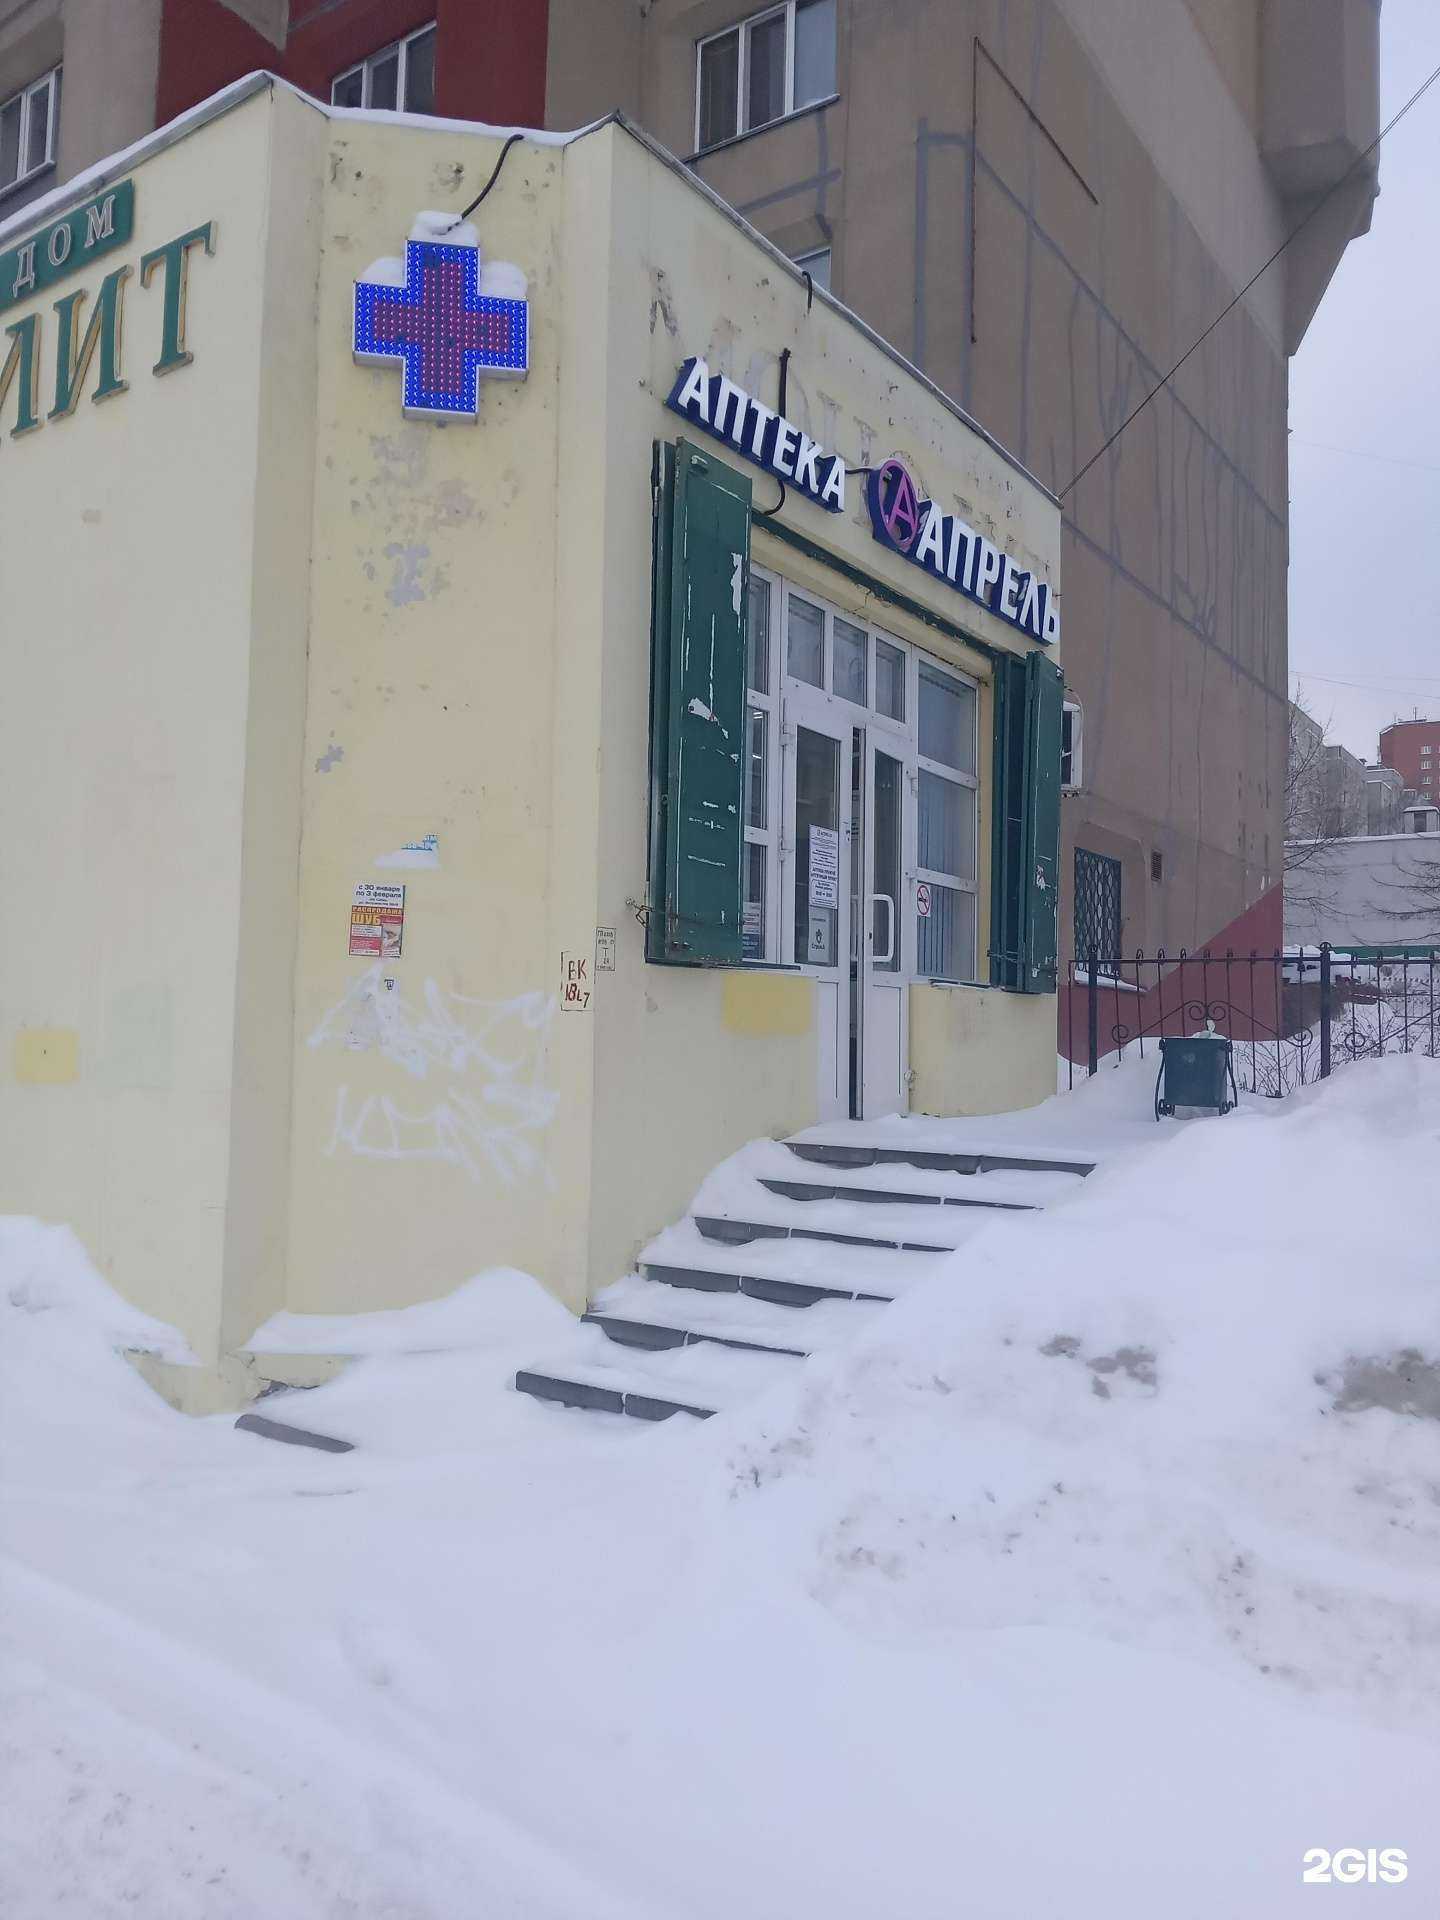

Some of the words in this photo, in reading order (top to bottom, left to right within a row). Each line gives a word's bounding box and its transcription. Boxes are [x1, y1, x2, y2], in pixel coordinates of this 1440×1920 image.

[12, 194, 116, 298] ДОМ
[677, 356, 846, 512] АПТЕКА
[915, 501, 1059, 643] АПРЕЛЬ
